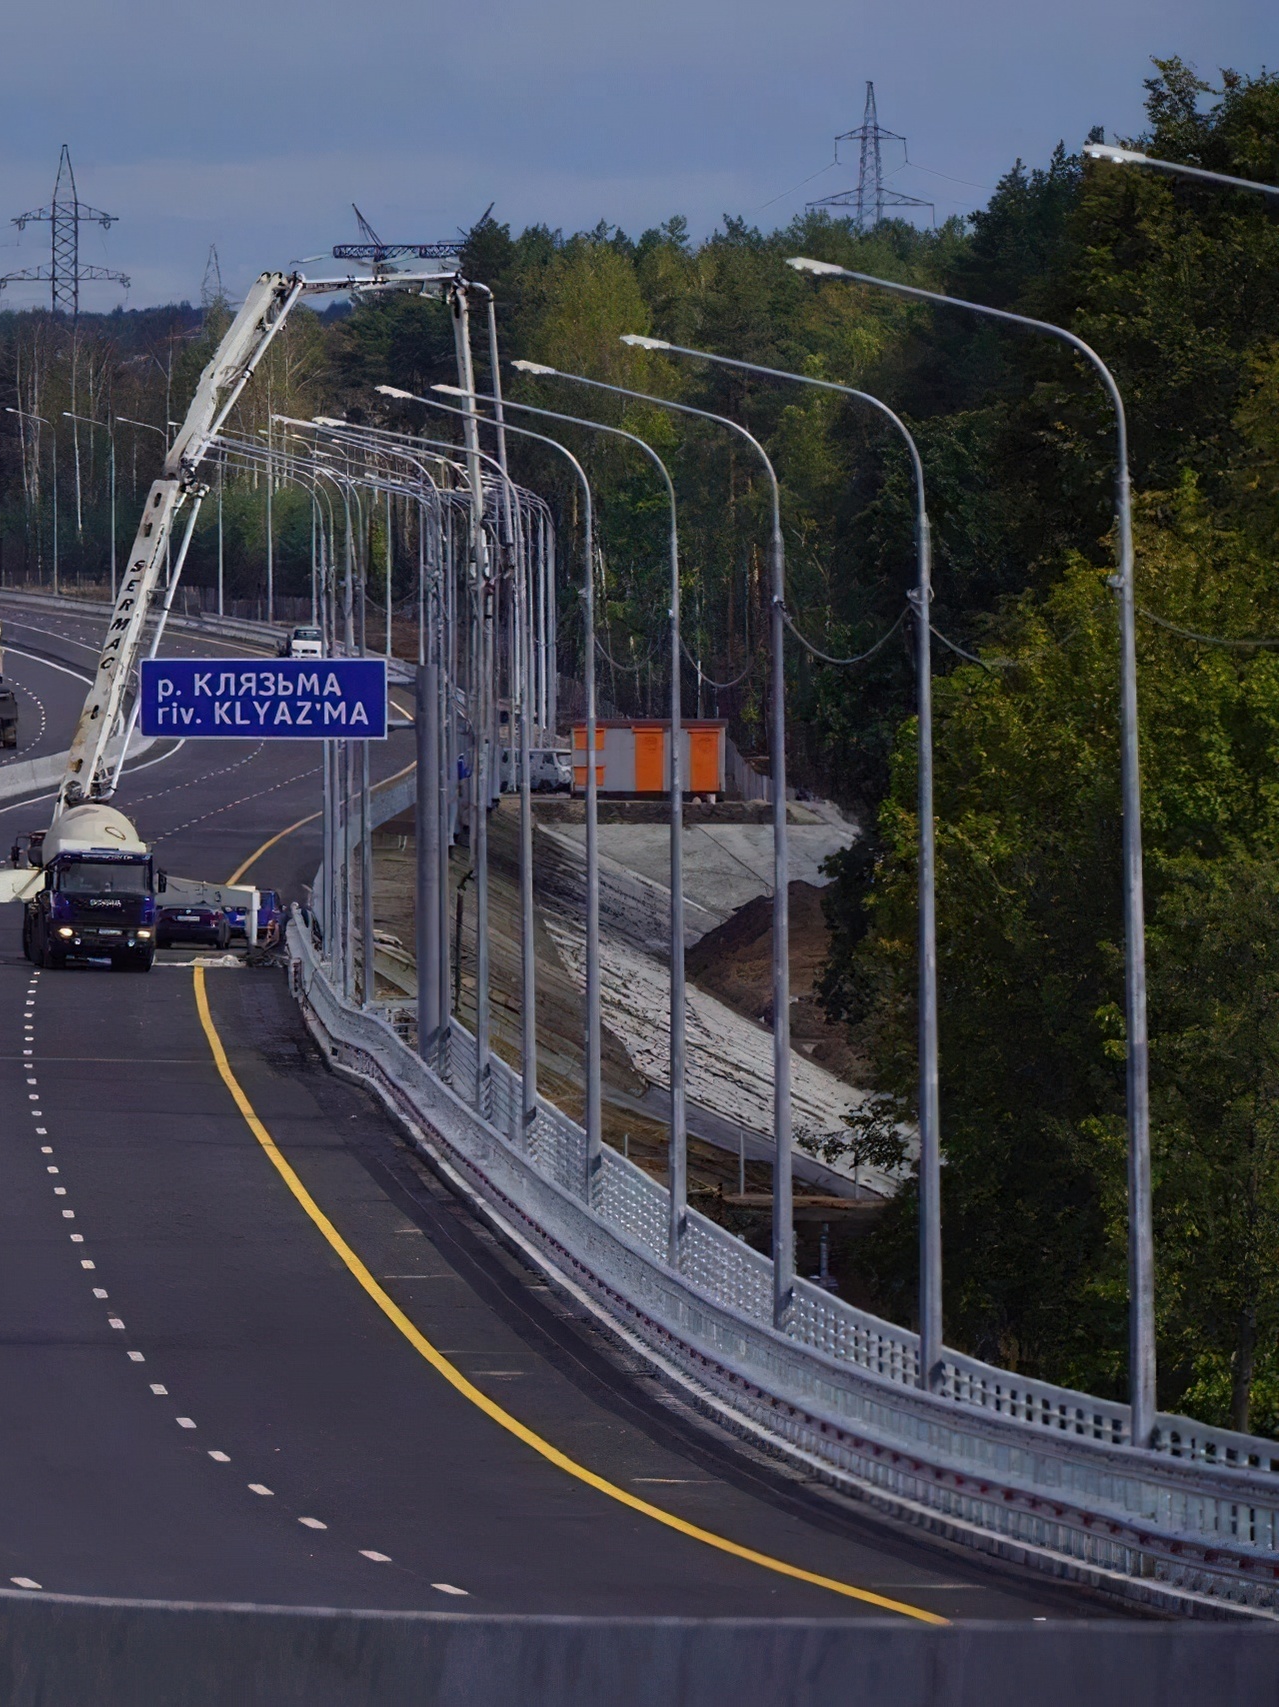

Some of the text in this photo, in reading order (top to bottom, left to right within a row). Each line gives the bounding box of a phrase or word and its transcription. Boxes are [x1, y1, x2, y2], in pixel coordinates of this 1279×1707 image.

[100, 560, 146, 670] SERMAC
[157, 673, 342, 702] р. КЛЯЗЬМА
[158, 701, 369, 725] riv. KLYAZ'MA
